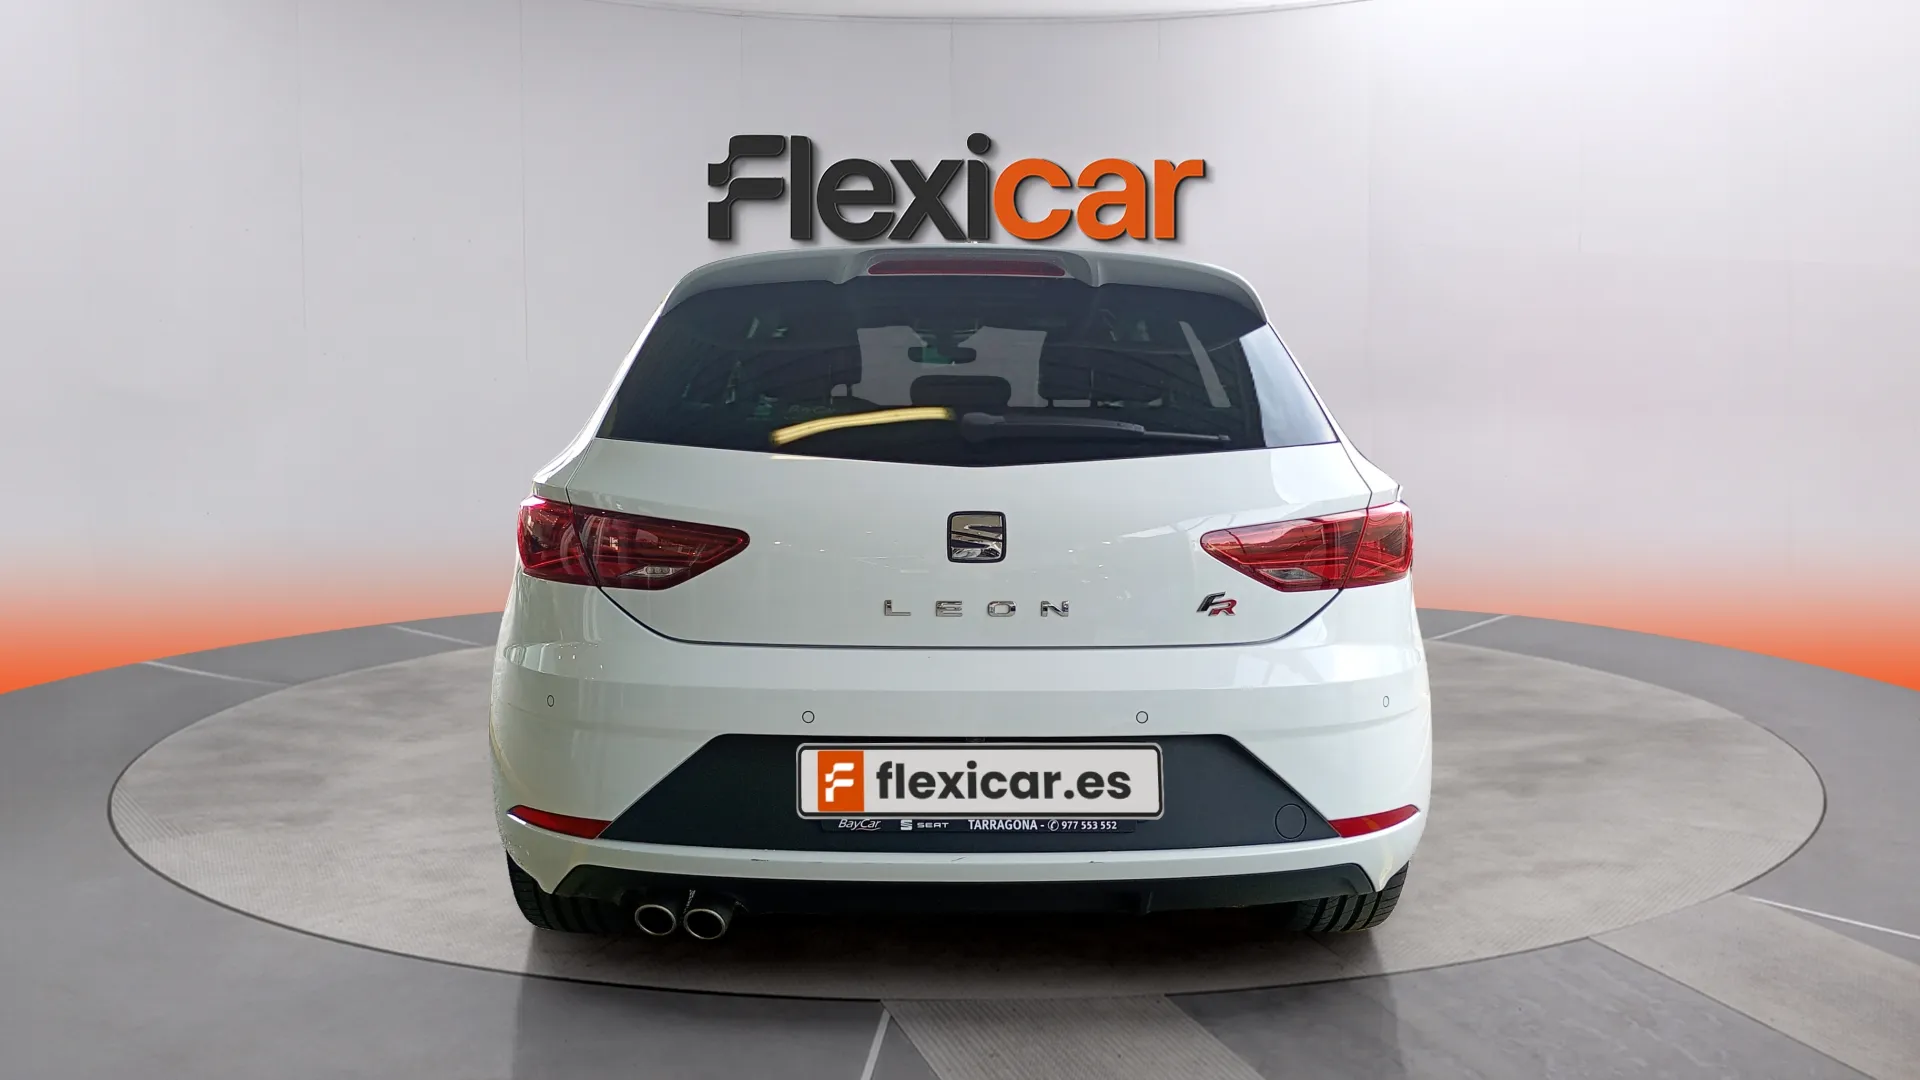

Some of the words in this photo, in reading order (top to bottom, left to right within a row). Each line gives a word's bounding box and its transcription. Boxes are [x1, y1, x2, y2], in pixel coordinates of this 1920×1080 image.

[708, 132, 1204, 241] Flexicar
[884, 599, 1070, 617] LEON
[1196, 591, 1238, 617] FR
[876, 760, 1132, 800] flexicar.es
[838, 819, 882, 831] BayCar
[968, 819, 1038, 830] TARRAGONA
[1061, 820, 1079, 830] 977
[1081, 820, 1098, 830] 553
[1100, 820, 1118, 830] 552
